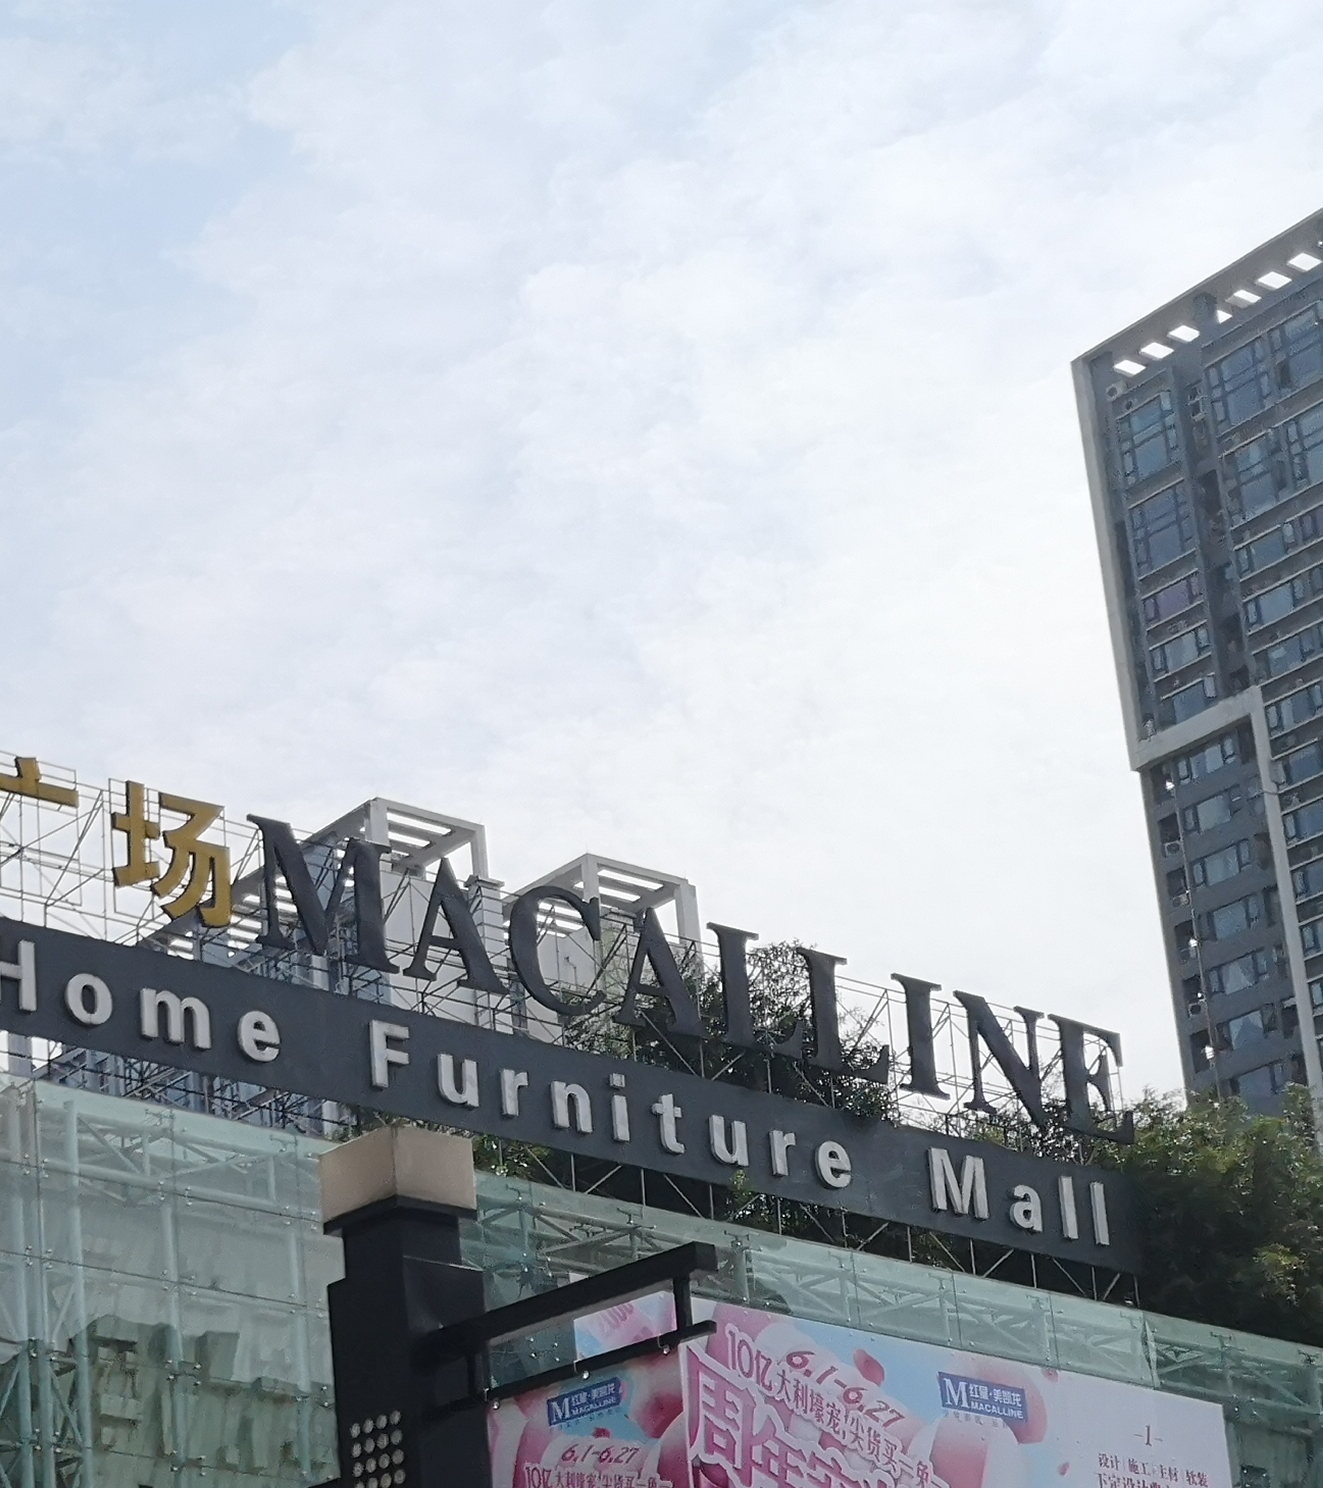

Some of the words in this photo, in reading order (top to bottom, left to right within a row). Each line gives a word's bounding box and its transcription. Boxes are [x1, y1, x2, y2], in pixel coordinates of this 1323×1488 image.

[247, 813, 1135, 1144] MACALLINE
[369, 1019, 852, 1189] Furniture
[928, 1146, 1110, 1247] Mall
[786, 1350, 906, 1429] 6.1-6.27
[970, 1401, 1024, 1420] MACALLINE
[561, 1443, 640, 1464] 6.1-6.27
